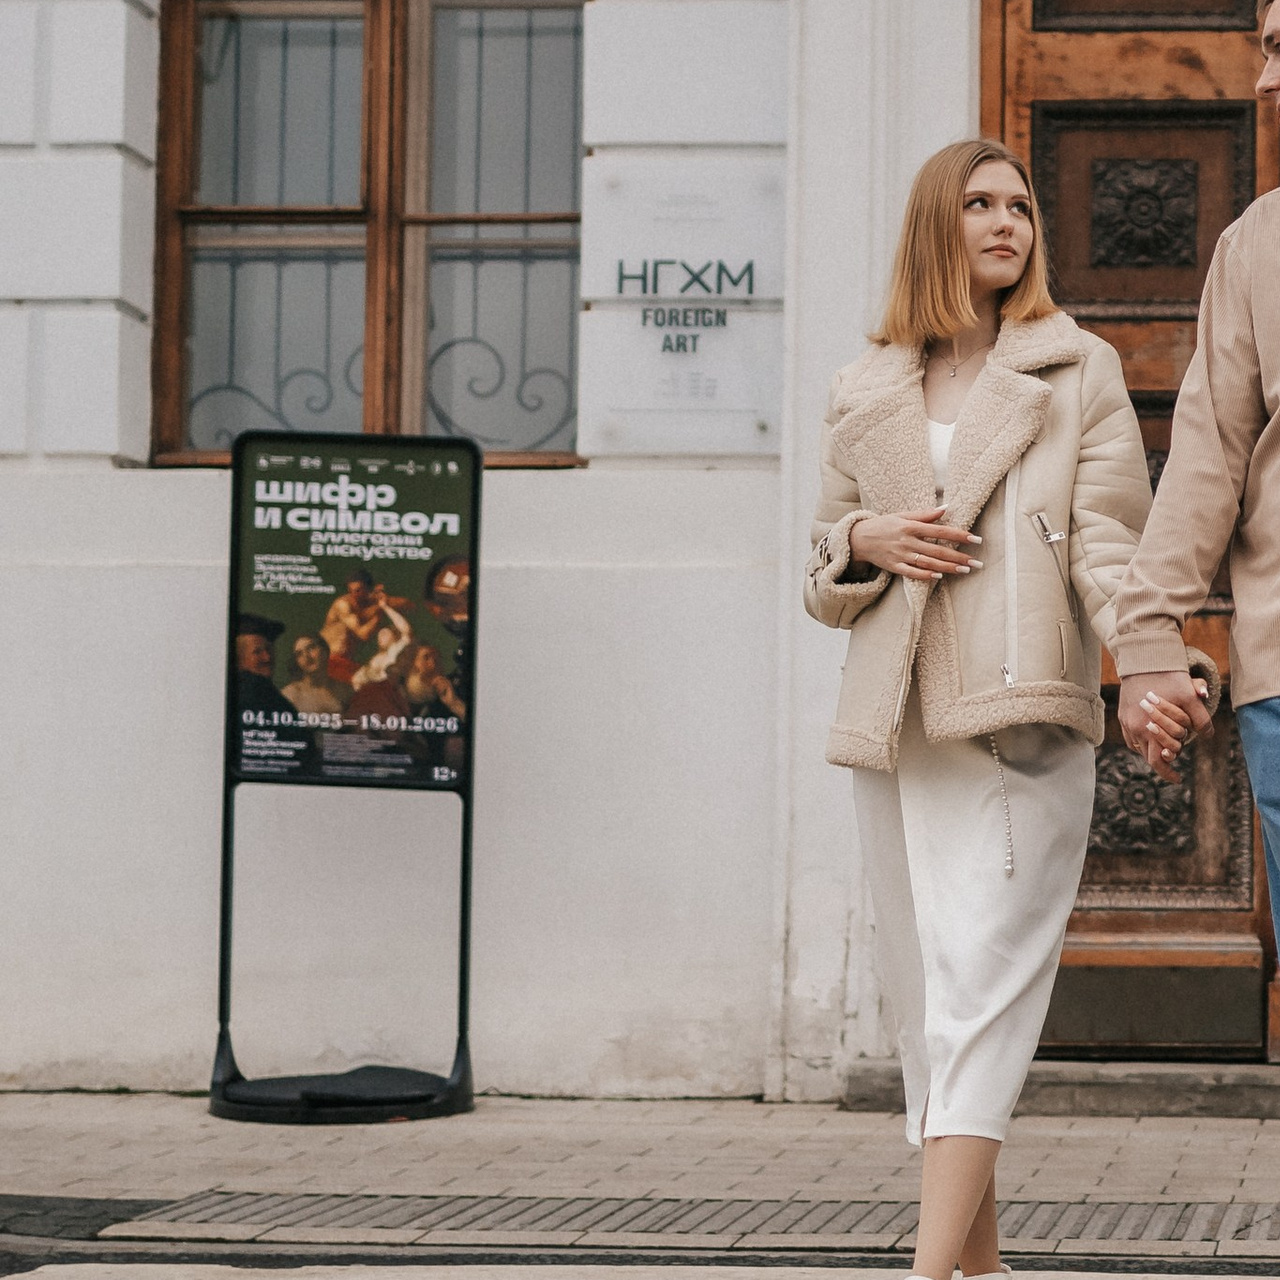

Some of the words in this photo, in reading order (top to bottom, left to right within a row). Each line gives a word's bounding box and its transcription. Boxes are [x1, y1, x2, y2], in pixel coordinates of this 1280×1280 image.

[617, 258, 754, 295] НГХМ
[641, 306, 728, 328] FOREIGN
[661, 332, 700, 353] ART
[255, 474, 398, 510] шифр
[254, 506, 283, 530] и
[286, 507, 461, 536] символ
[310, 531, 424, 547] аллегории
[326, 546, 434, 562] искусстве
